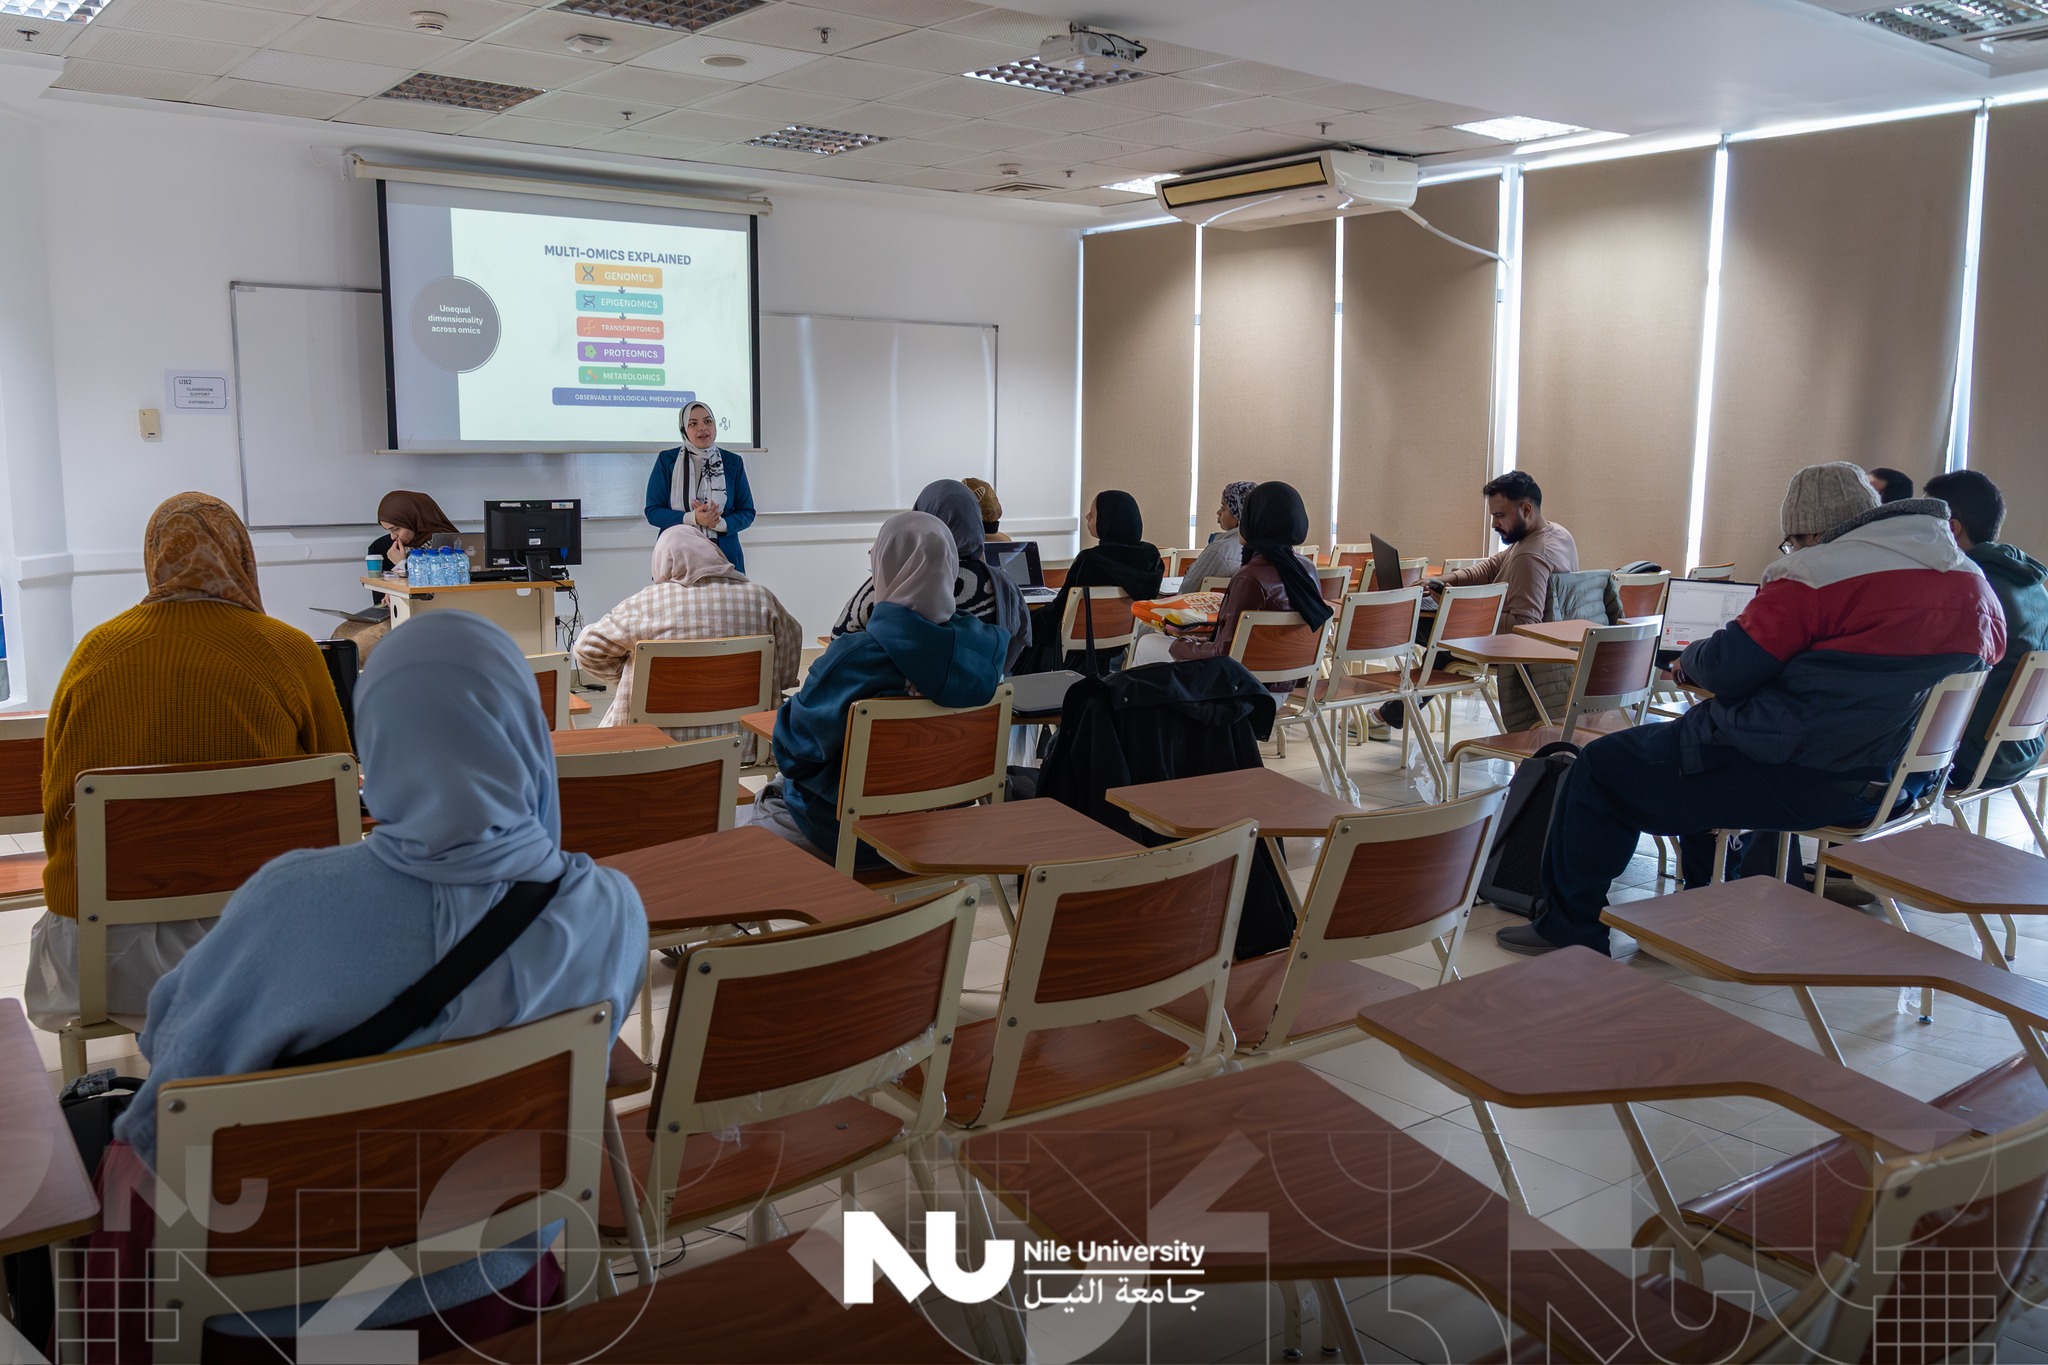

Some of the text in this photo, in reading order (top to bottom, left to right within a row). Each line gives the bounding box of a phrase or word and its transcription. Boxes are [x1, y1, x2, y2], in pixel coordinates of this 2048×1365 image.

[544, 245, 691, 265] MULTI-OMICS EXPLAINED
[604, 271, 654, 283] GENOMICS
[601, 298, 658, 309] EPIGENOMICS
[439, 304, 471, 314] Unequal
[427, 314, 484, 326] dimensionality
[458, 326, 481, 335] omics
[601, 324, 660, 334] TRANSCRIPTOMICS
[603, 348, 658, 359] PROTEOMICS
[602, 372, 661, 382] METABOLOMICS
[574, 393, 687, 403] OBSERVABLE BIOLOGICAL PHENOTYPES
